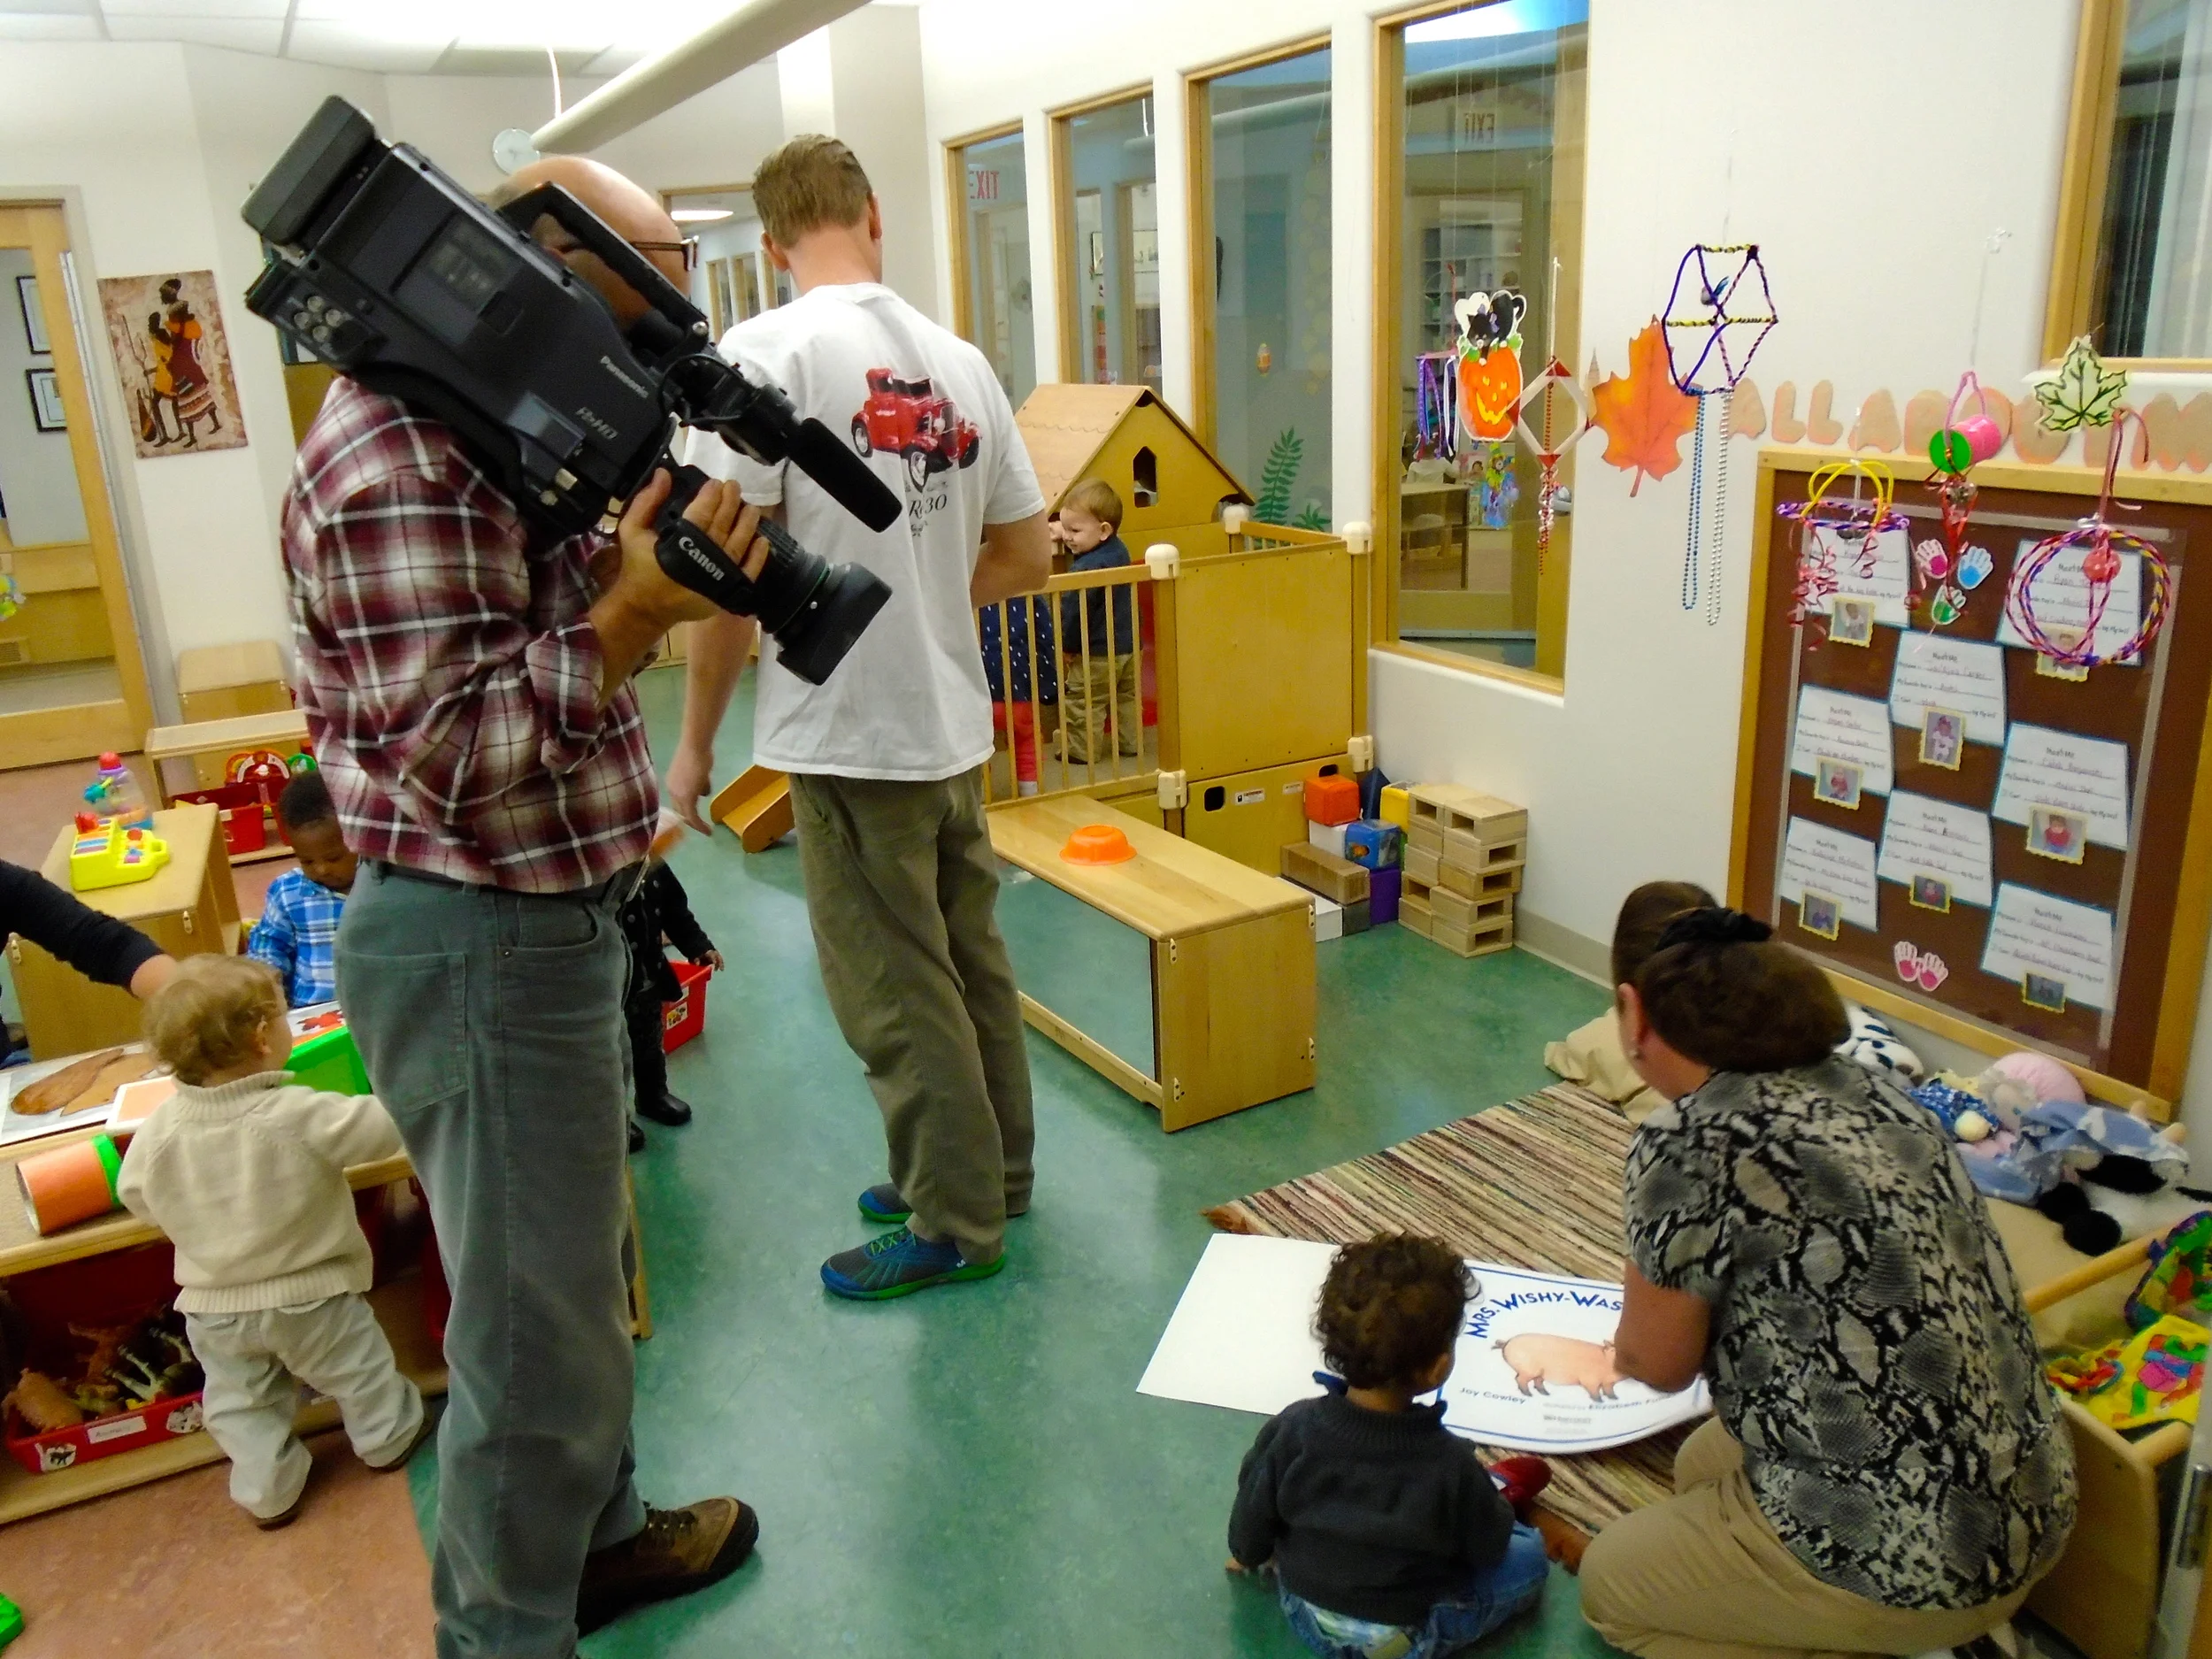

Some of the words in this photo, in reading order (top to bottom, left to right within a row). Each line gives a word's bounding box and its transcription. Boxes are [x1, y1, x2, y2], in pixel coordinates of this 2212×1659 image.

[600, 356, 649, 399] Panasonic
[678, 536, 726, 581] Canon
[1465, 1307, 1501, 1339] MRS.
[1489, 1290, 1624, 1311] WISHY-WAS
[1459, 1386, 1480, 1397] Joy
[1483, 1391, 1526, 1404] Cowley
